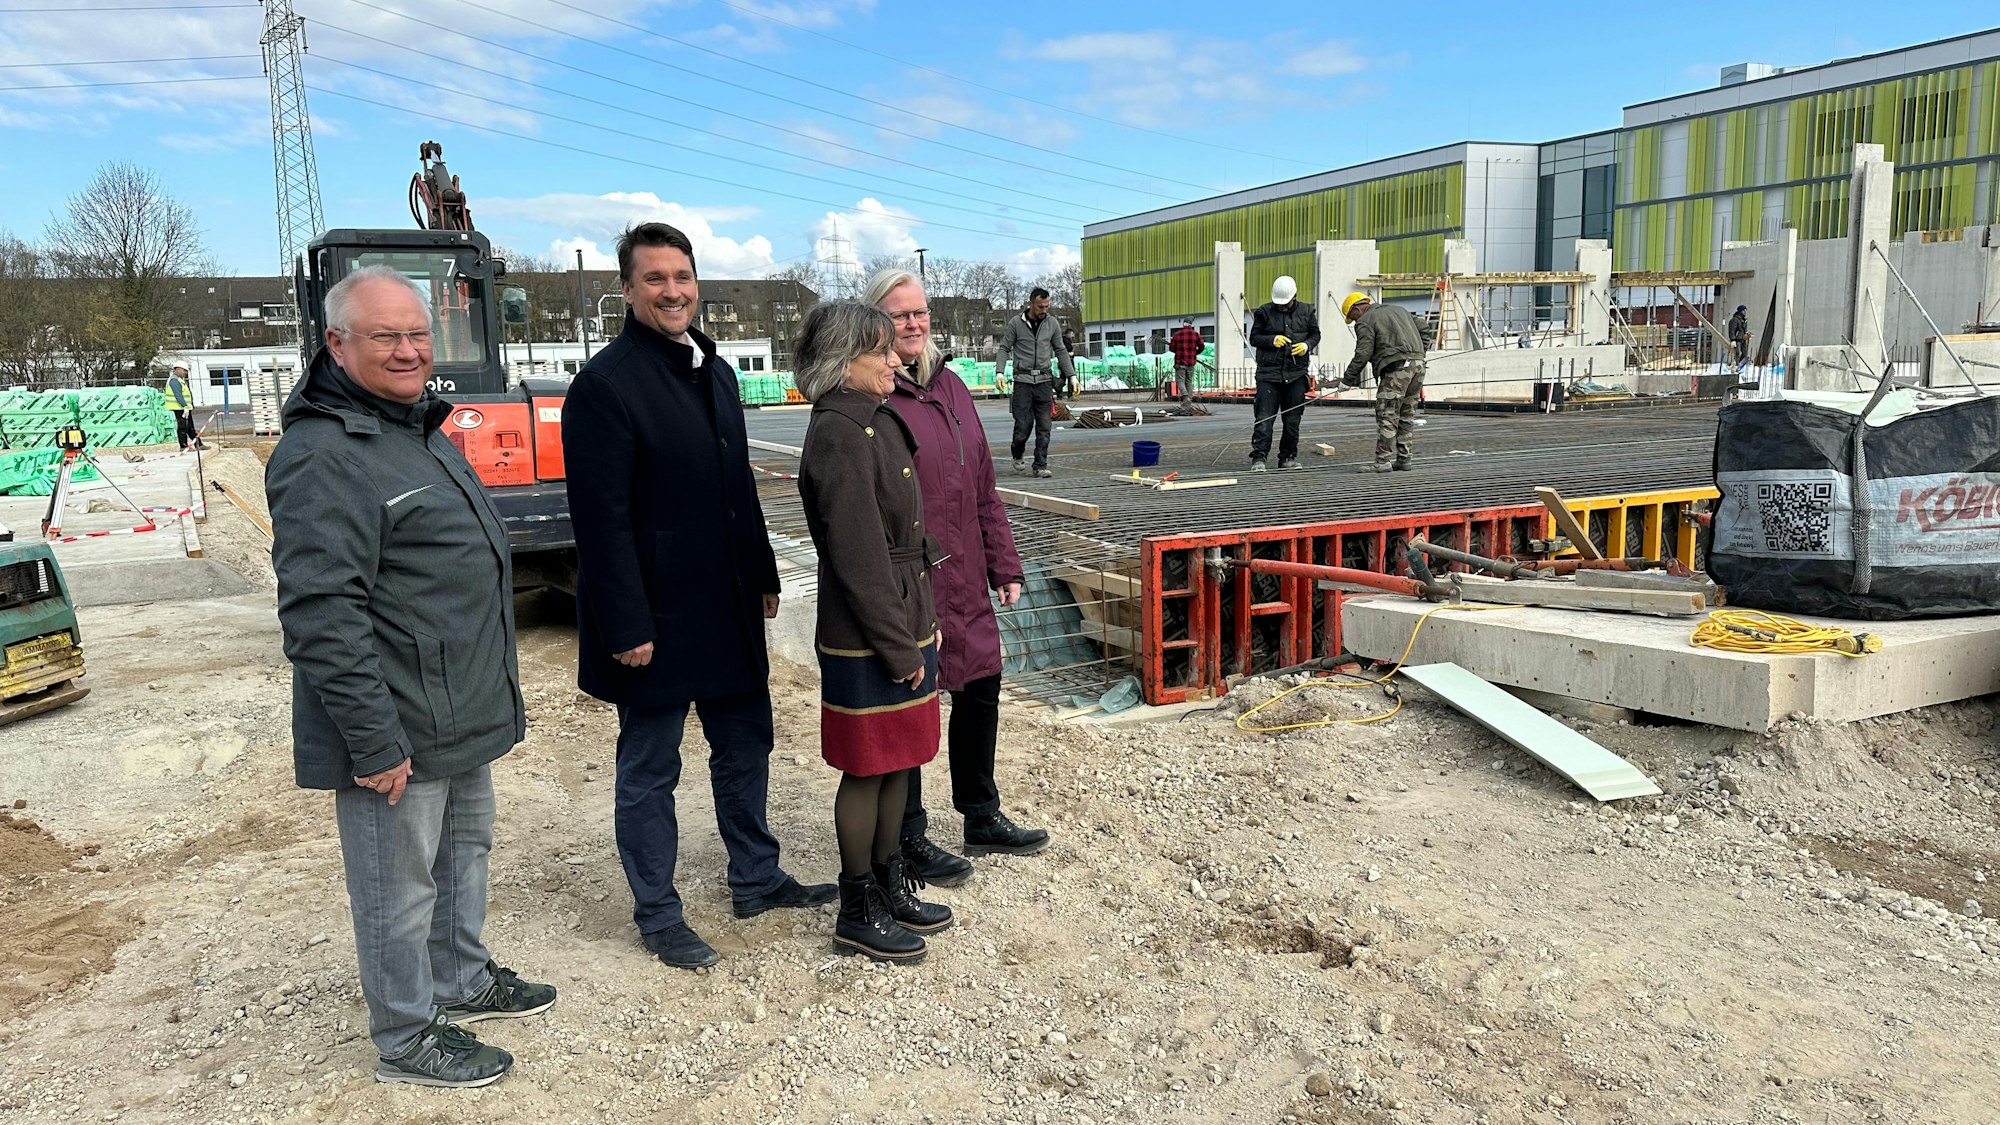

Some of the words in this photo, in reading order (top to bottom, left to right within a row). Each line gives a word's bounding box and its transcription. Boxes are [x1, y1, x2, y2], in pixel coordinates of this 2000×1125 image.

[426, 376, 456, 391] ota
[1896, 478, 2000, 533] KÖBI
[1937, 543, 1962, 553] ums
[1964, 540, 1999, 552] Bauen
[417, 1047, 454, 1077] N
